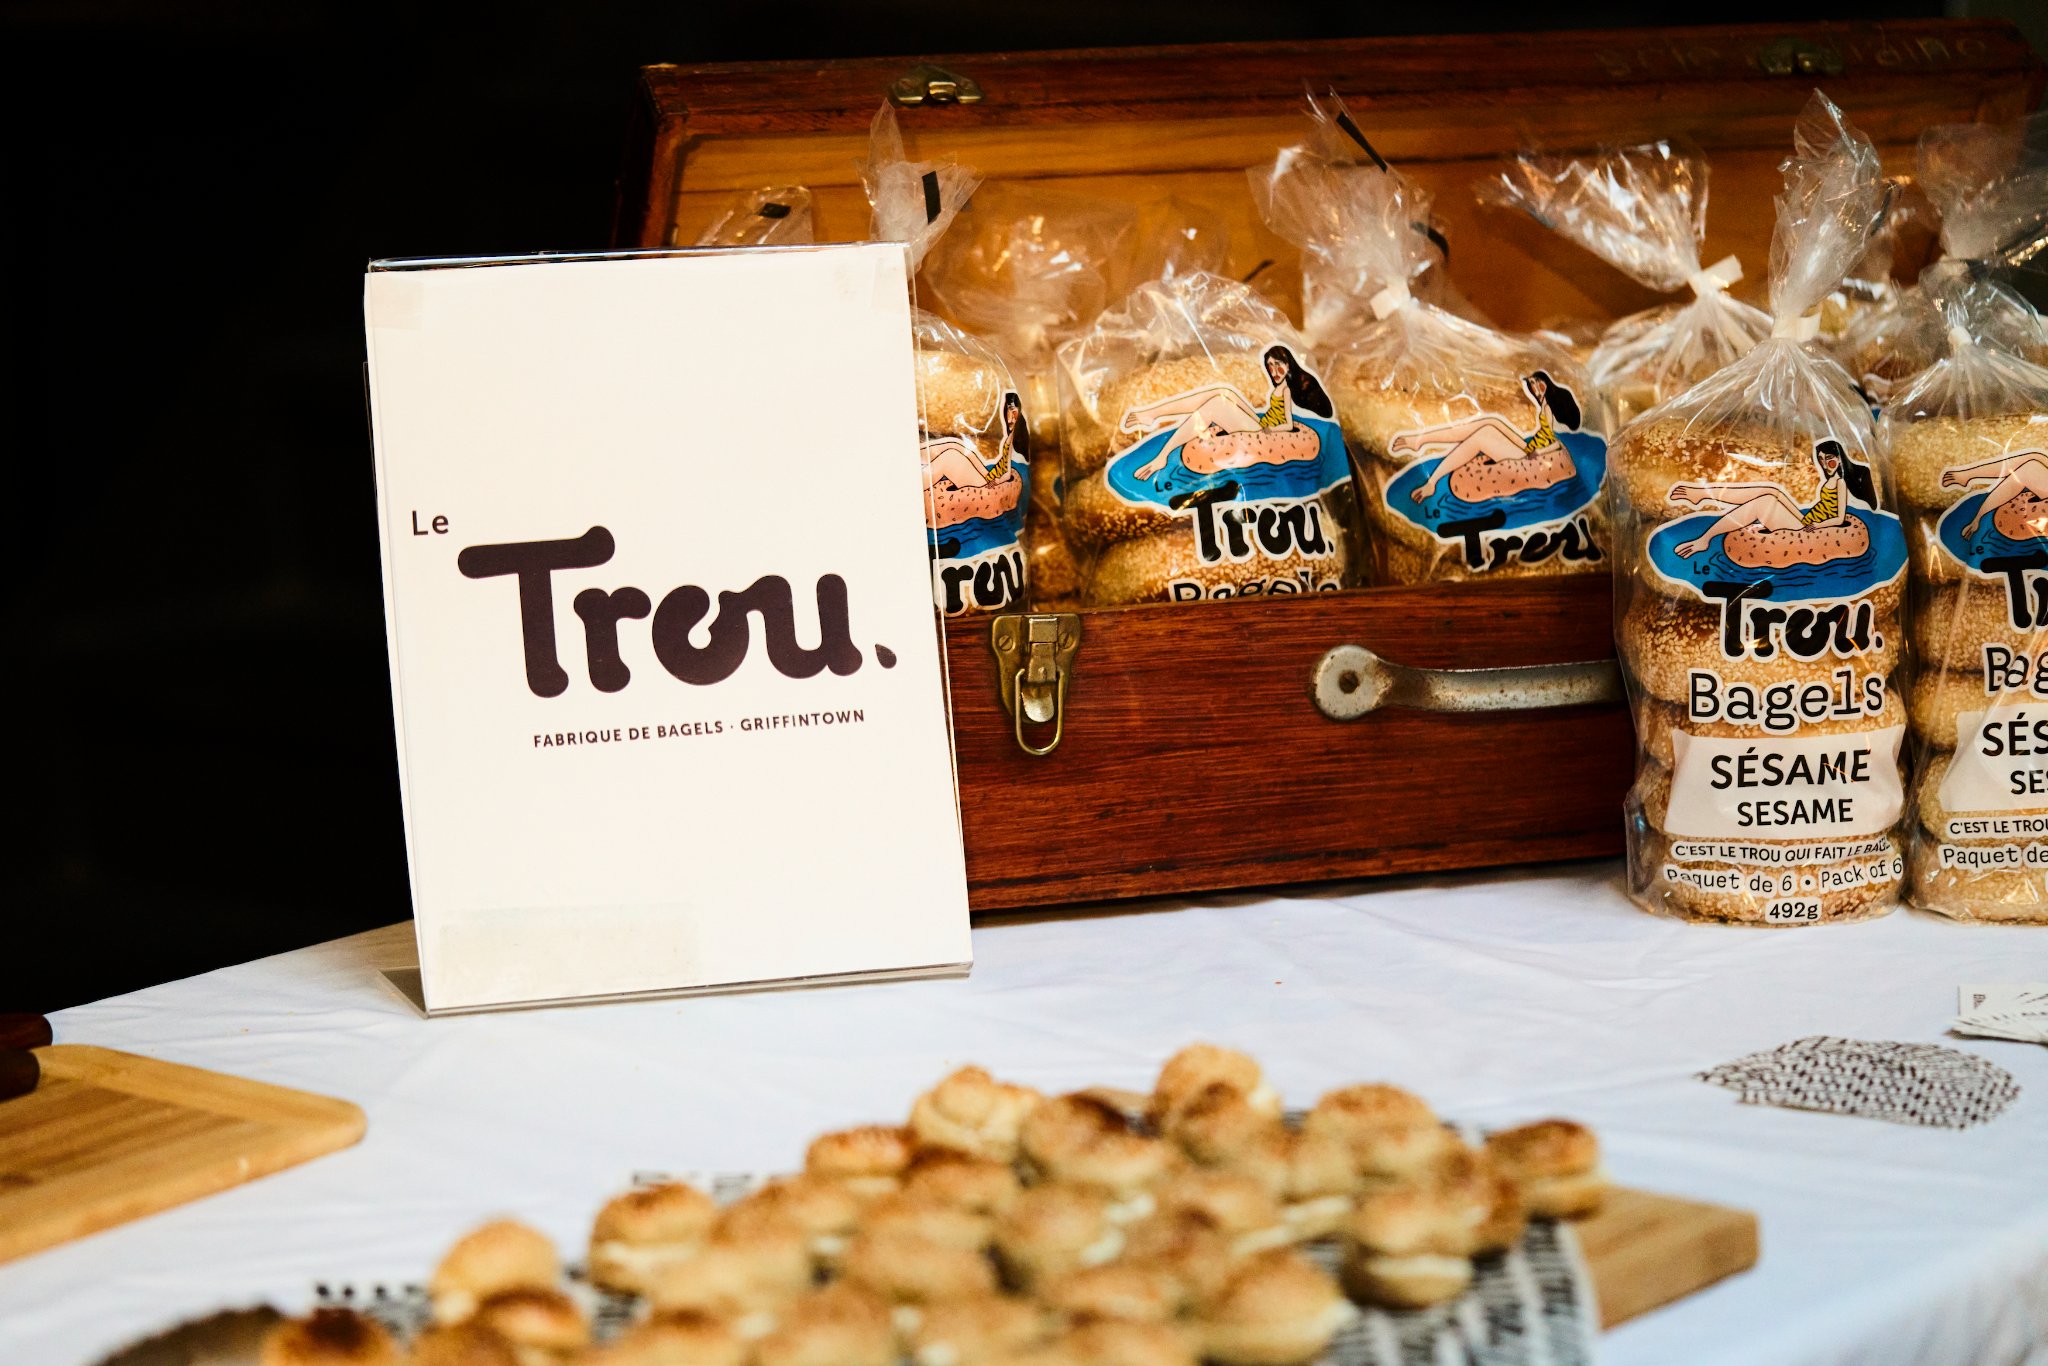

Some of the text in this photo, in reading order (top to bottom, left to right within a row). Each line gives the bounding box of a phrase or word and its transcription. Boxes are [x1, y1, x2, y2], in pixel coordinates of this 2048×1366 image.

[1155, 481, 1173, 493] Le
[411, 510, 449, 535] Le
[1169, 480, 1334, 562] Trou.
[1424, 506, 1441, 519] Le
[1693, 561, 1710, 575] Le
[457, 525, 897, 698] Trou.
[1702, 580, 1884, 657] Trou.
[1691, 670, 1883, 730] Bagels
[533, 709, 865, 748] FABRIQUE DE BAGELS GRIFFINTOWN
[1710, 747, 1871, 790] SÉSAME
[2010, 769, 2048, 795] SE
[1737, 798, 1853, 827] SESAME
[1950, 818, 2048, 834] C'EST LE TRO
[1675, 845, 1715, 856] C'EST
[1720, 846, 1737, 857] LE
[1739, 847, 1780, 862] TROU
[1785, 848, 1810, 861] QUI
[1815, 846, 1846, 859] FAIT
[1943, 847, 2018, 868] Paquet
[1667, 857, 1902, 892] Paquet de 6 Pack of 6
[1769, 902, 1818, 919] 492g
